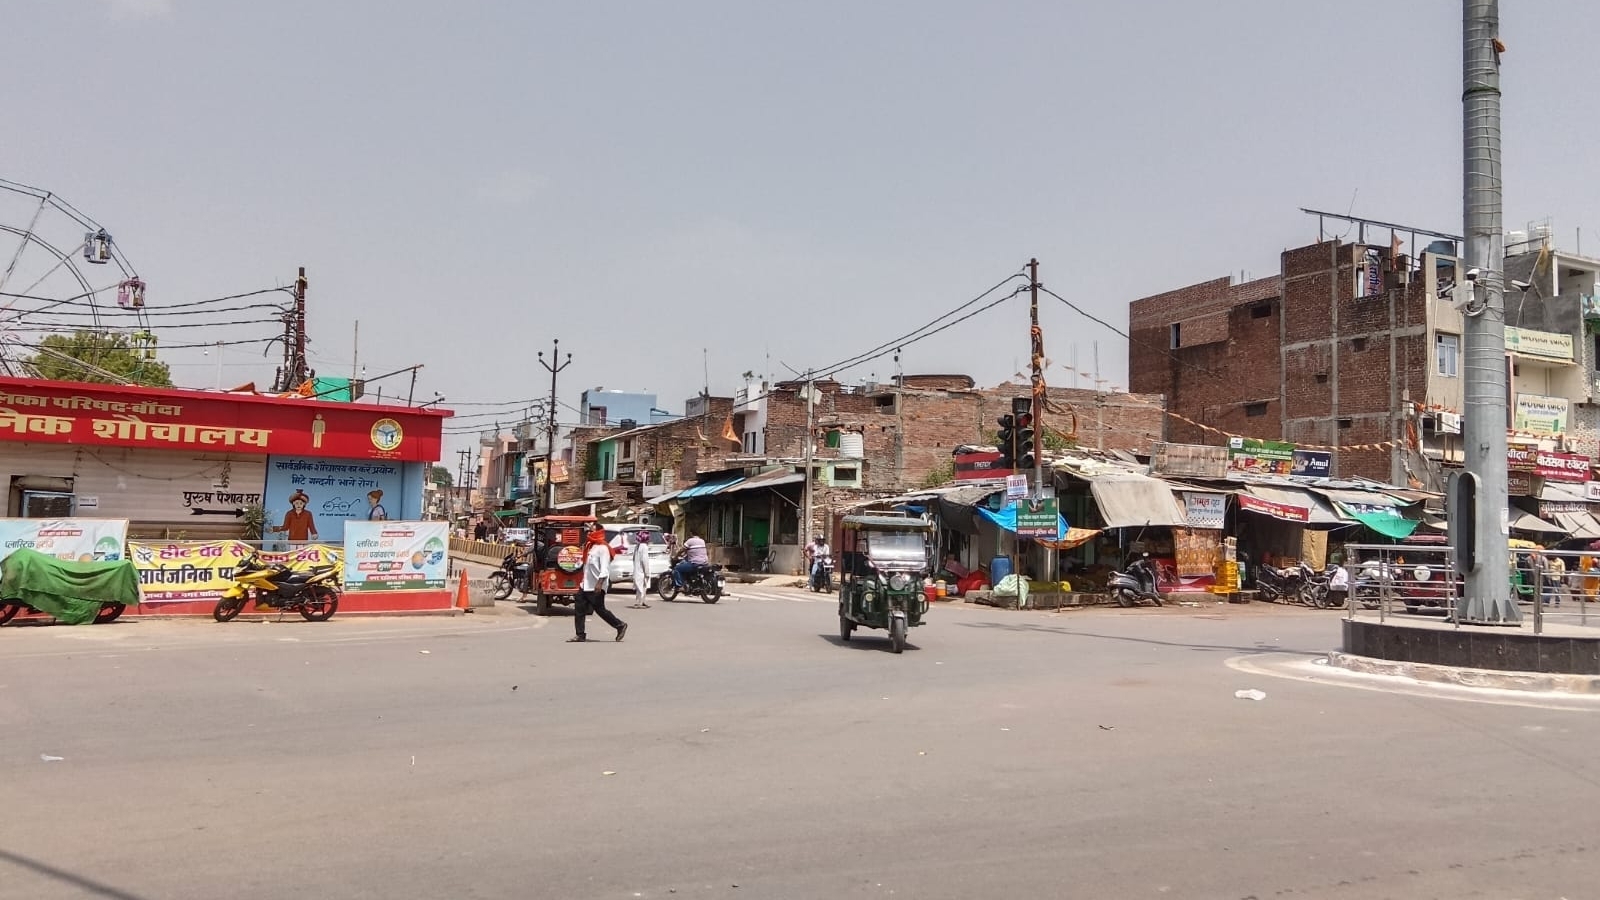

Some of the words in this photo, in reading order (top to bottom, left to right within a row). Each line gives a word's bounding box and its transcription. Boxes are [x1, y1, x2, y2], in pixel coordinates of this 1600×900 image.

[91, 414, 273, 447] शौचालय
[275, 459, 314, 471] सार्वजनिक
[314, 460, 347, 473] शौचालय
[1309, 457, 1329, 467] Amul
[291, 475, 307, 485] मिटे
[245, 493, 261, 505] घर
[5, 538, 36, 549] प्लास्टिक
[139, 563, 213, 584] सार्वजनिक
